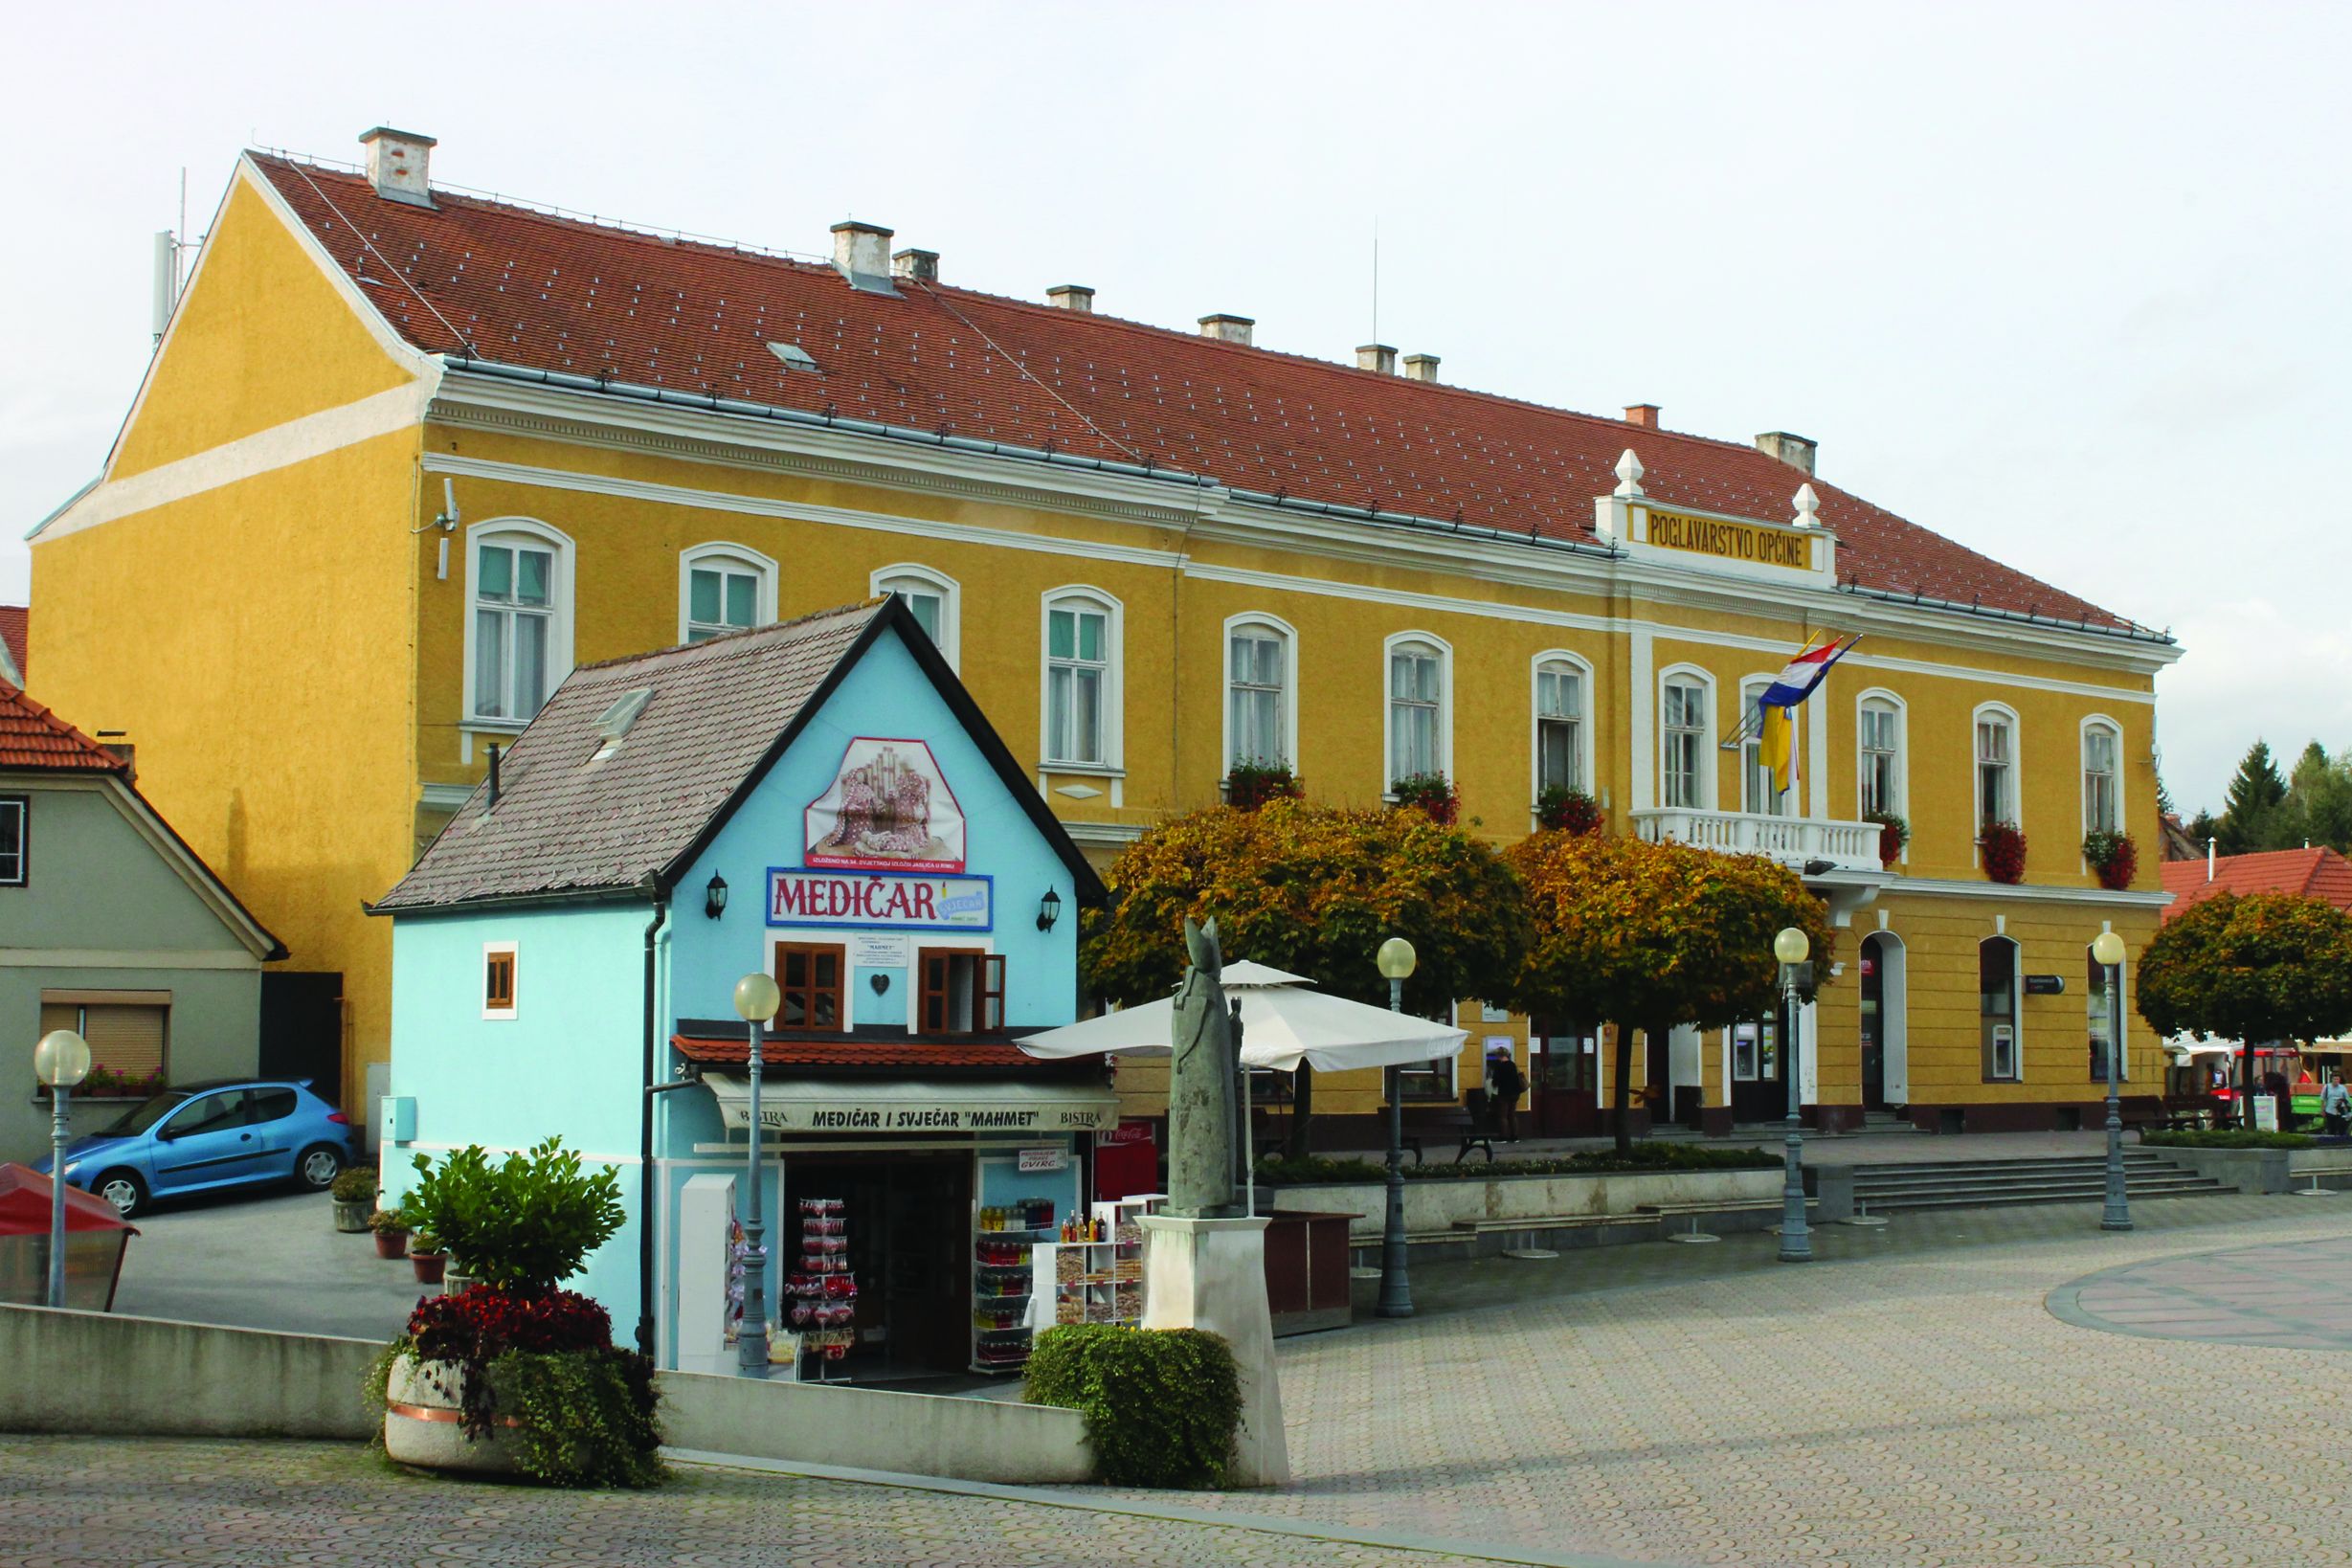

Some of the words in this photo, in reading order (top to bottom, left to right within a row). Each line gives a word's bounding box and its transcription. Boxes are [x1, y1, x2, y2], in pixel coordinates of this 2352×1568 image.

[1651, 514, 1753, 558] POGLAVARSTVO
[1758, 530, 1803, 567] OPĆINE
[773, 875, 936, 920] MEDIČAR
[740, 1109, 788, 1123] BTRA
[812, 1108, 880, 1128] MEDIČAR
[885, 1111, 891, 1127] I
[897, 1108, 959, 1128] SVJEČAR
[965, 1111, 1040, 1127] "MAHMET"
[1061, 1111, 1101, 1125] BISTRA
[1021, 1160, 1056, 1169] GVIRC
